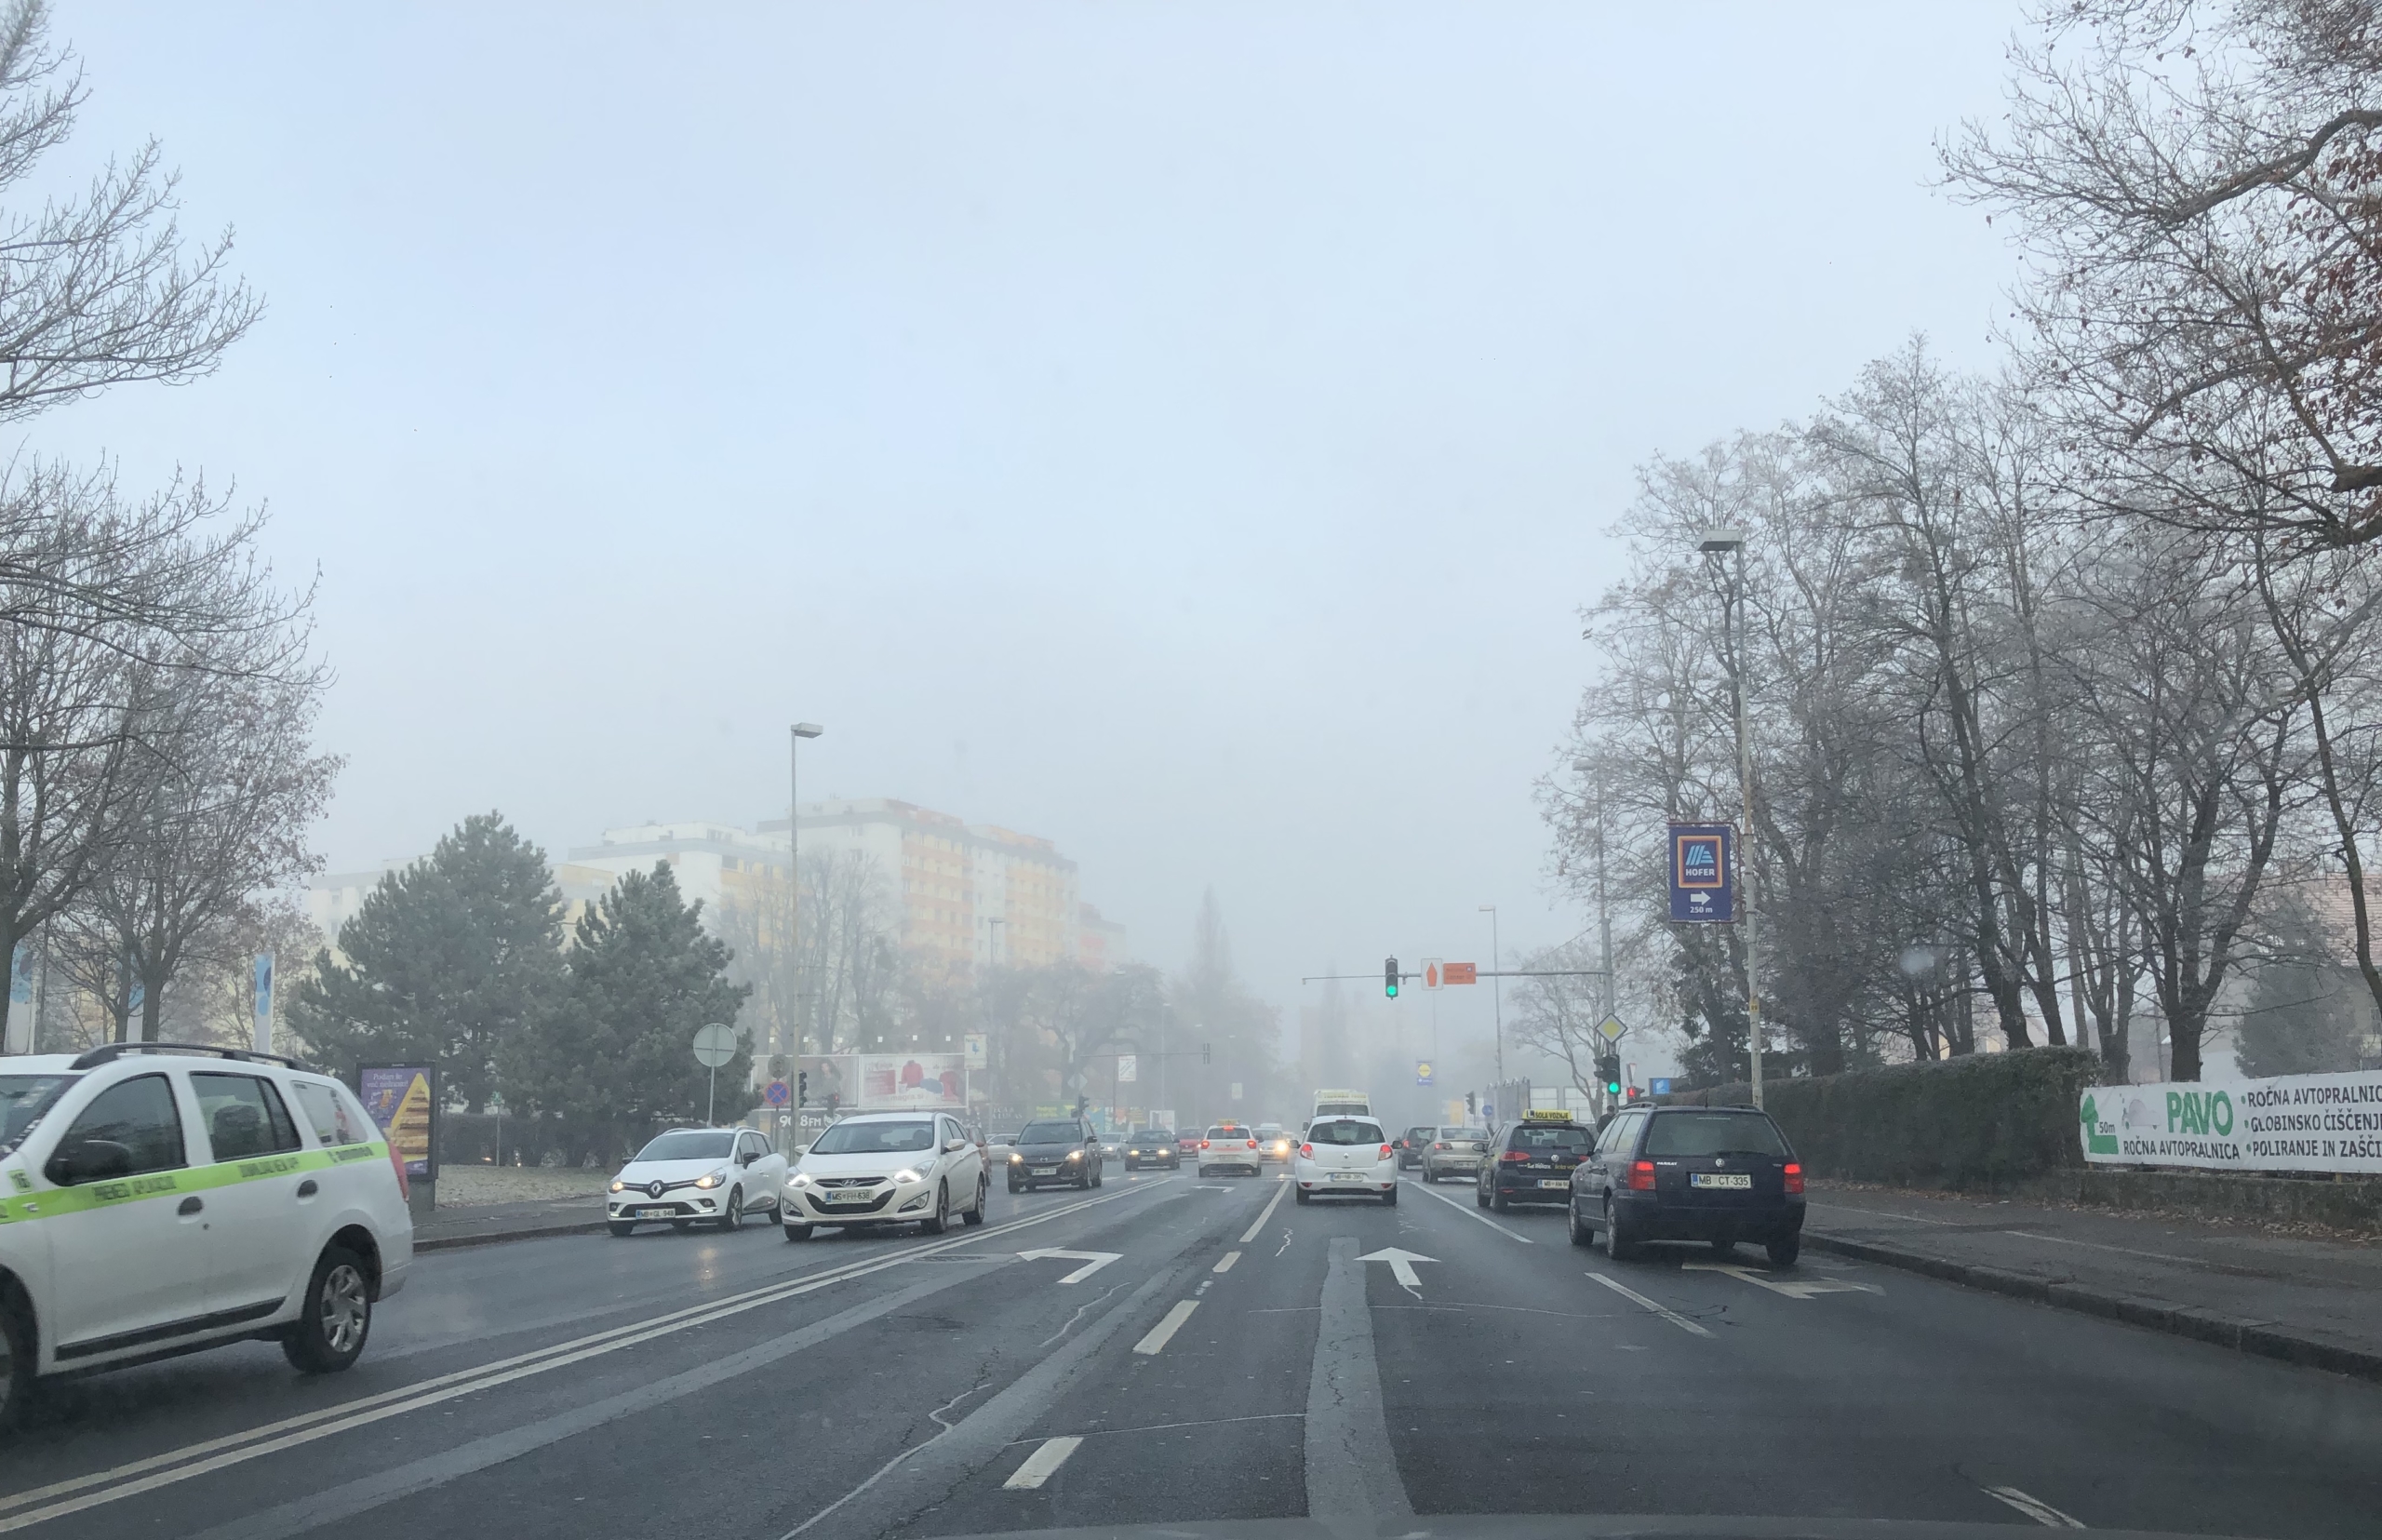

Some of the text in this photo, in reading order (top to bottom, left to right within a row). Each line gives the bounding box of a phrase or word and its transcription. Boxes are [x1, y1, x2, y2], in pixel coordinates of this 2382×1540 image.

[1685, 868, 1715, 877] HOFER
[2247, 1085, 2290, 1107] ROČNA
[2165, 1090, 2233, 1137] PAVO
[2251, 1107, 2382, 1132] GLOBINSKO ČIŠČENJ
[2099, 1121, 2116, 1134] 50m
[2123, 1135, 2241, 1160] ROČNA AVTOPRALNICA
[2253, 1140, 2318, 1157] POLIRANJE
[2322, 1140, 2336, 1157] IN
[1698, 1175, 1748, 1185] MB CT-335
